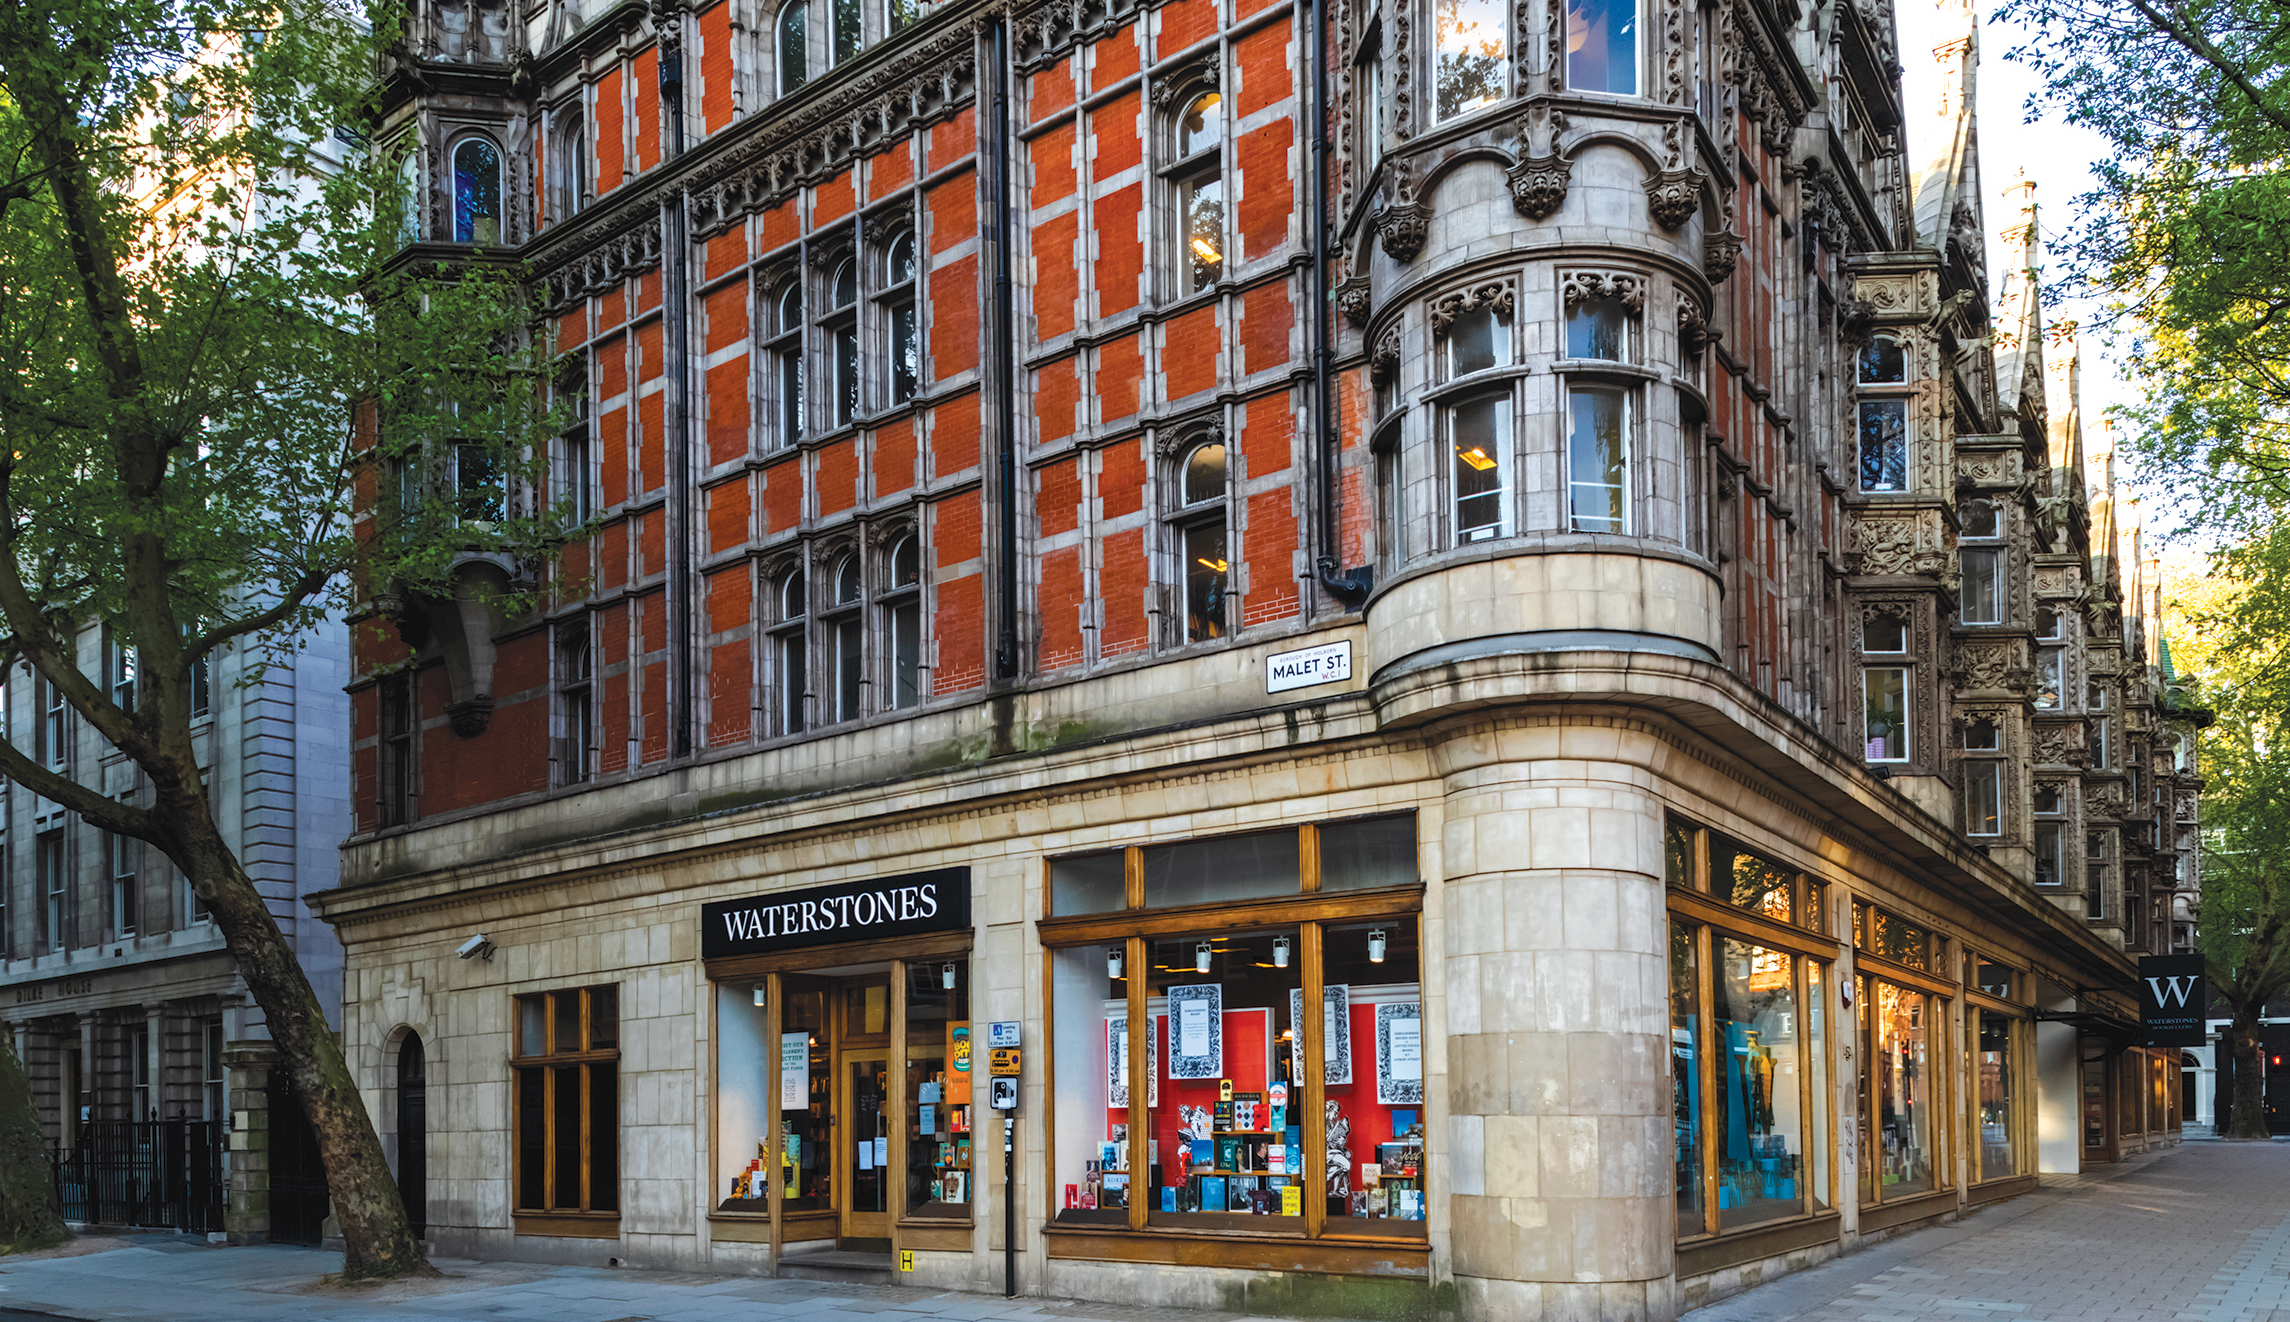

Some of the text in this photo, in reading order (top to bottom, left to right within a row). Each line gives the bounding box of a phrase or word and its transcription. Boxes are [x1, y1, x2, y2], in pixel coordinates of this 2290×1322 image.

[1273, 654, 1346, 680] MALET ST.
[1280, 654, 1302, 663] BOROUGH
[1314, 648, 1336, 656] HOLBORN
[722, 883, 938, 942] WATERSTONES
[16, 979, 92, 1003] DILKE HOUSE
[2144, 975, 2199, 1009] W
[954, 1040, 970, 1051] BOO
[902, 1252, 912, 1269] H
